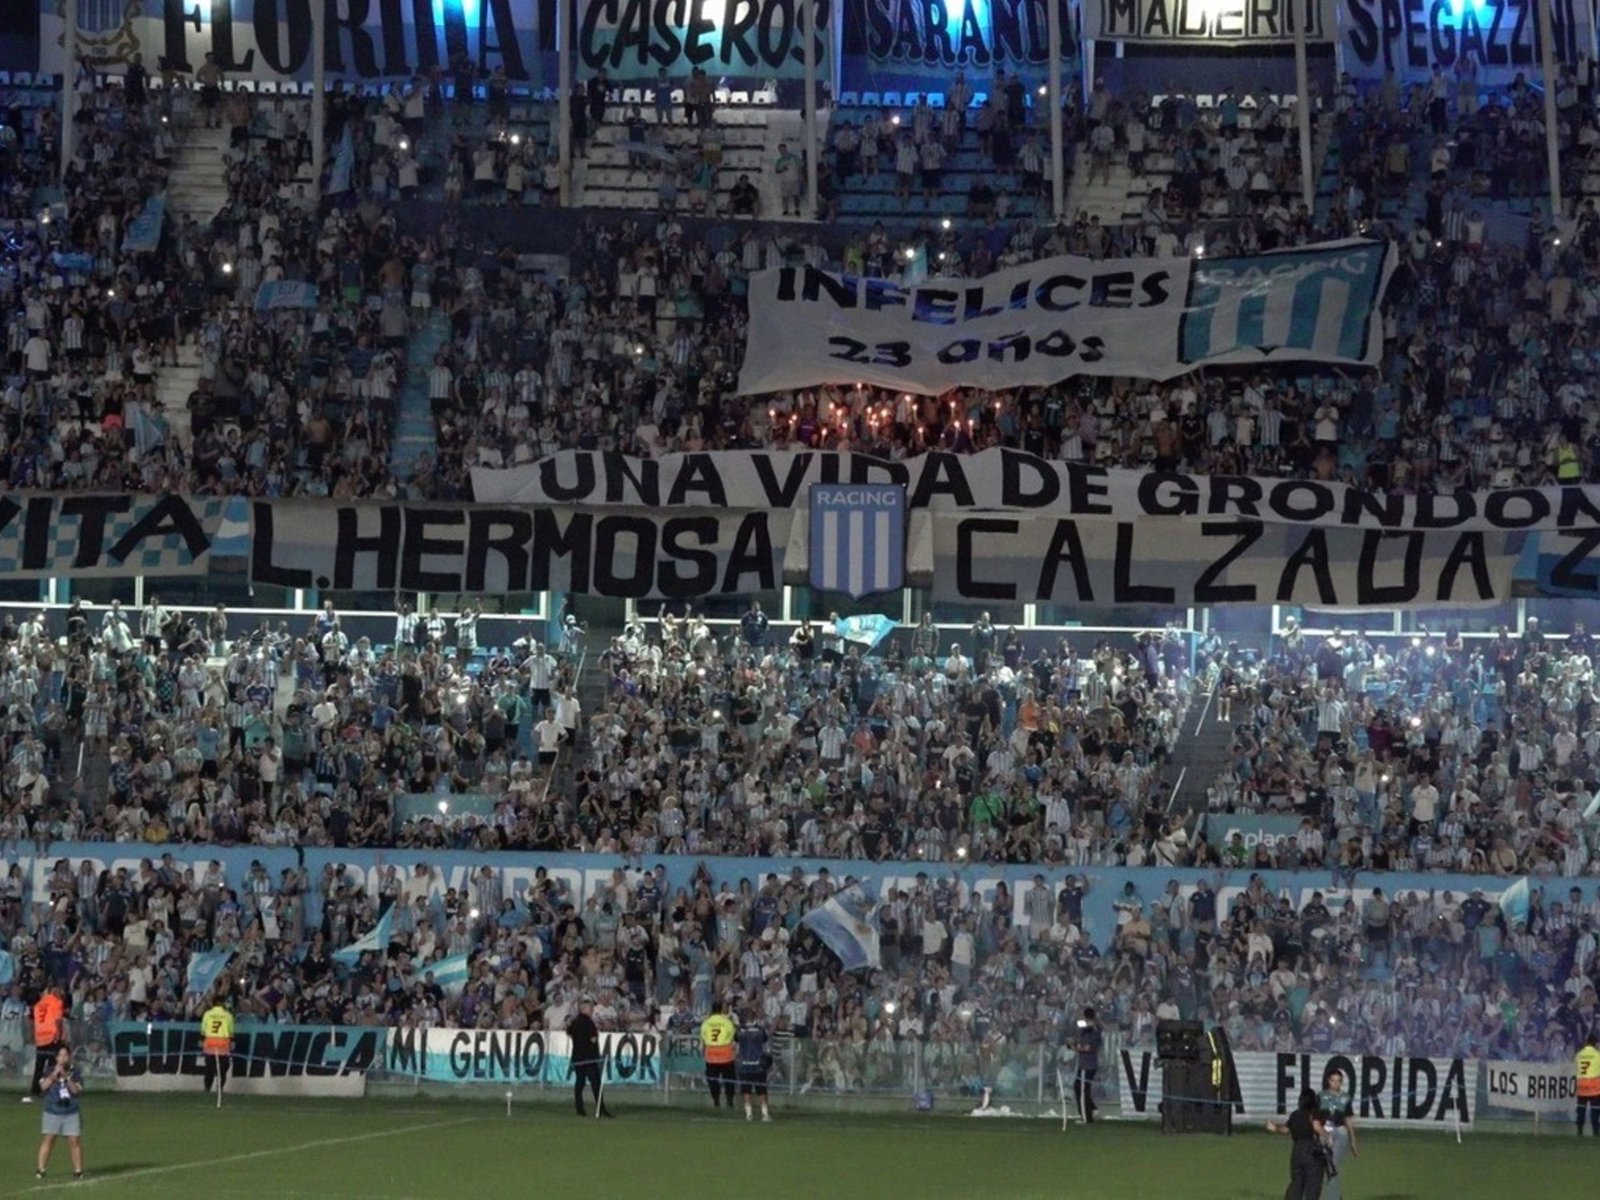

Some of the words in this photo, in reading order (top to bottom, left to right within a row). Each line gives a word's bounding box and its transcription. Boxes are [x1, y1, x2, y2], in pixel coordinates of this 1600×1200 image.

[580, 0, 830, 68] CASEROS
[777, 266, 1170, 325] INFELICES
[828, 336, 912, 367] 23
[937, 329, 1106, 365] años
[540, 452, 729, 507] UNA
[751, 450, 976, 508] VIDA
[1000, 448, 1112, 514] DE
[816, 491, 896, 506] RACING
[254, 502, 776, 599] L.HERMOSA
[957, 518, 1495, 605] CALZADA
[391, 1027, 428, 1075] MI
[450, 1031, 545, 1078] GENIO
[1490, 1069, 1518, 1095] LOS
[1277, 1053, 1470, 1123] FLORIDA
